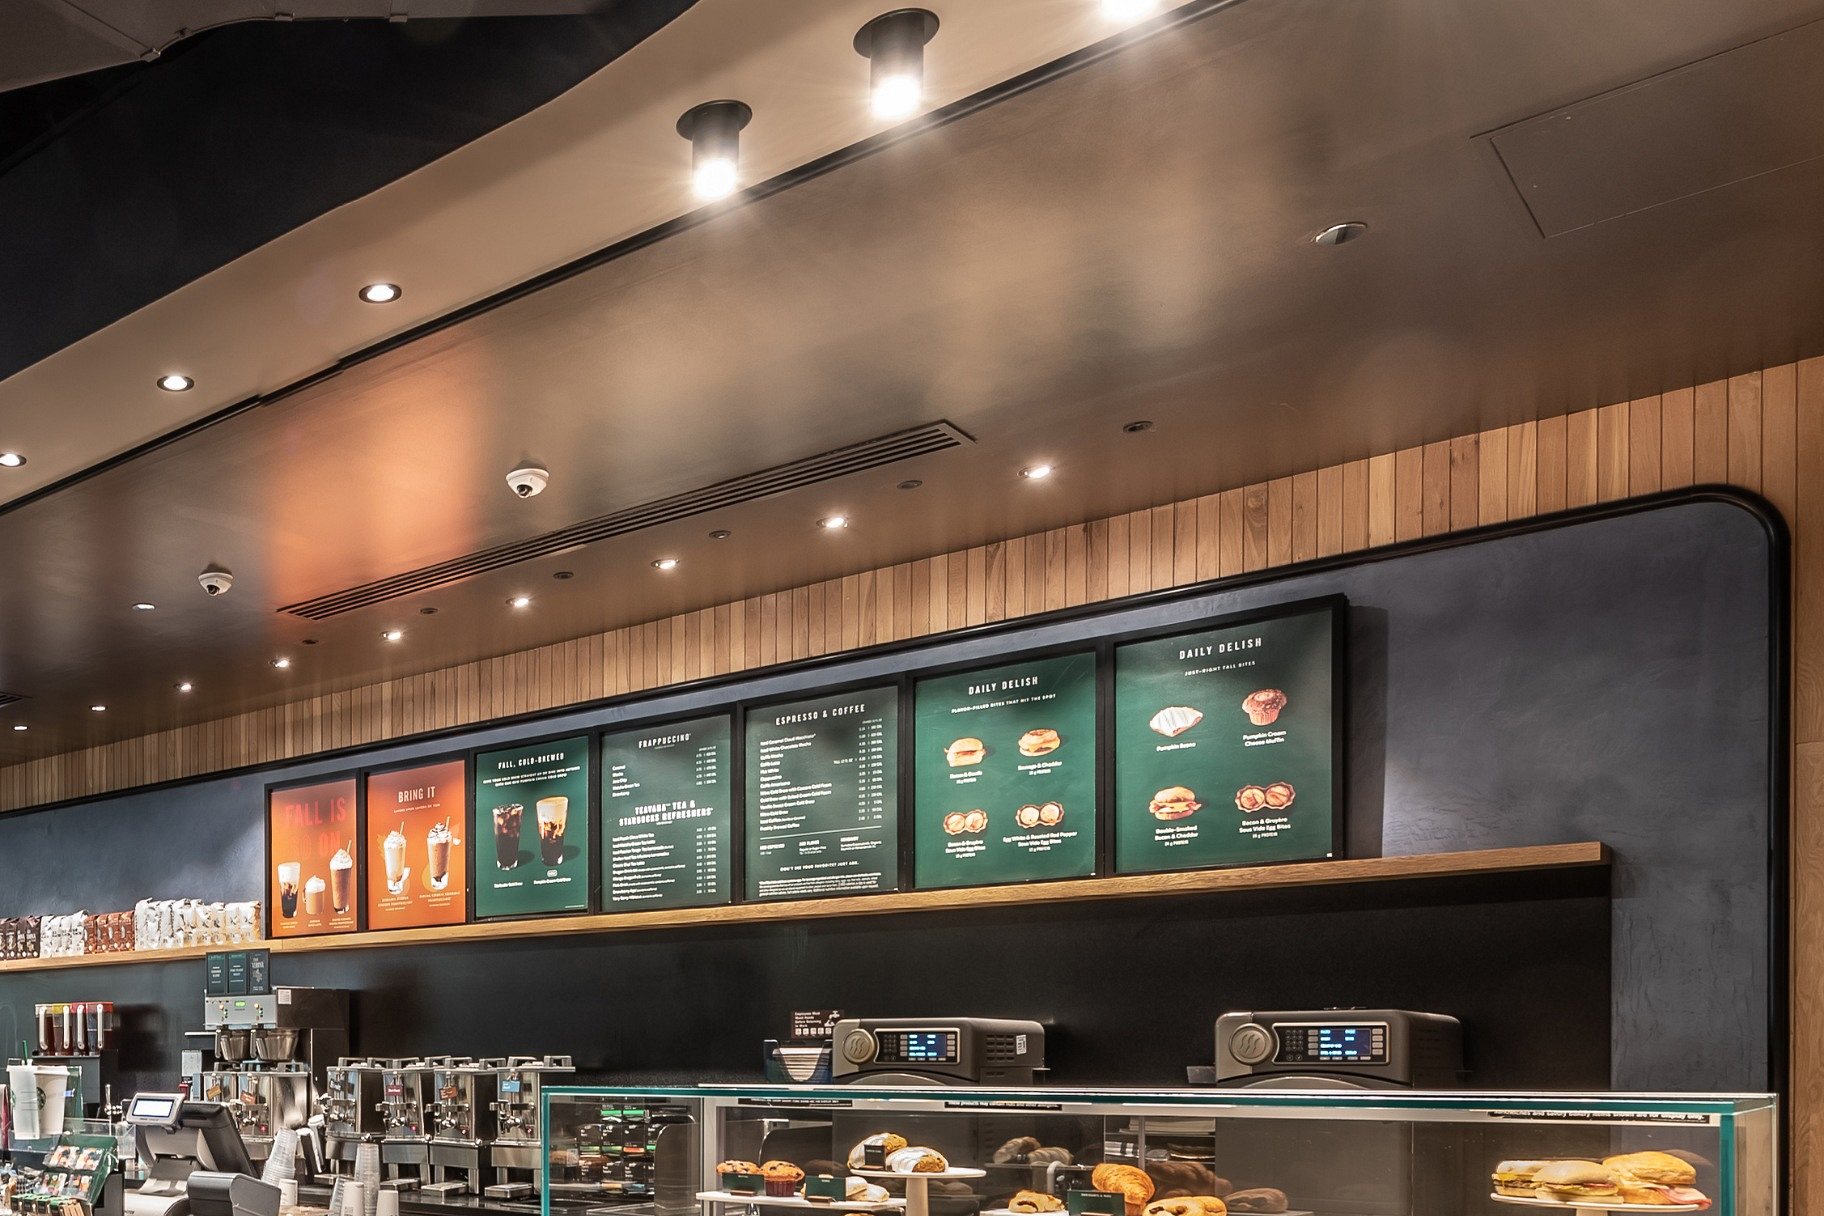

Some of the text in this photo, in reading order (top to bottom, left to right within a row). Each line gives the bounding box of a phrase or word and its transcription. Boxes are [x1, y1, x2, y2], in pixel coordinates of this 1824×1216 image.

[1180, 638, 1262, 660] DAILY DELISH
[968, 676, 1038, 695] DAILY DELISH
[776, 704, 865, 725] ESPRESSO & COFFEE
[498, 752, 565, 770] FALL, COLD-BREWED
[398, 786, 436, 803] BRING IT
[331, 797, 346, 822] IS
[672, 801, 687, 810] TEA
